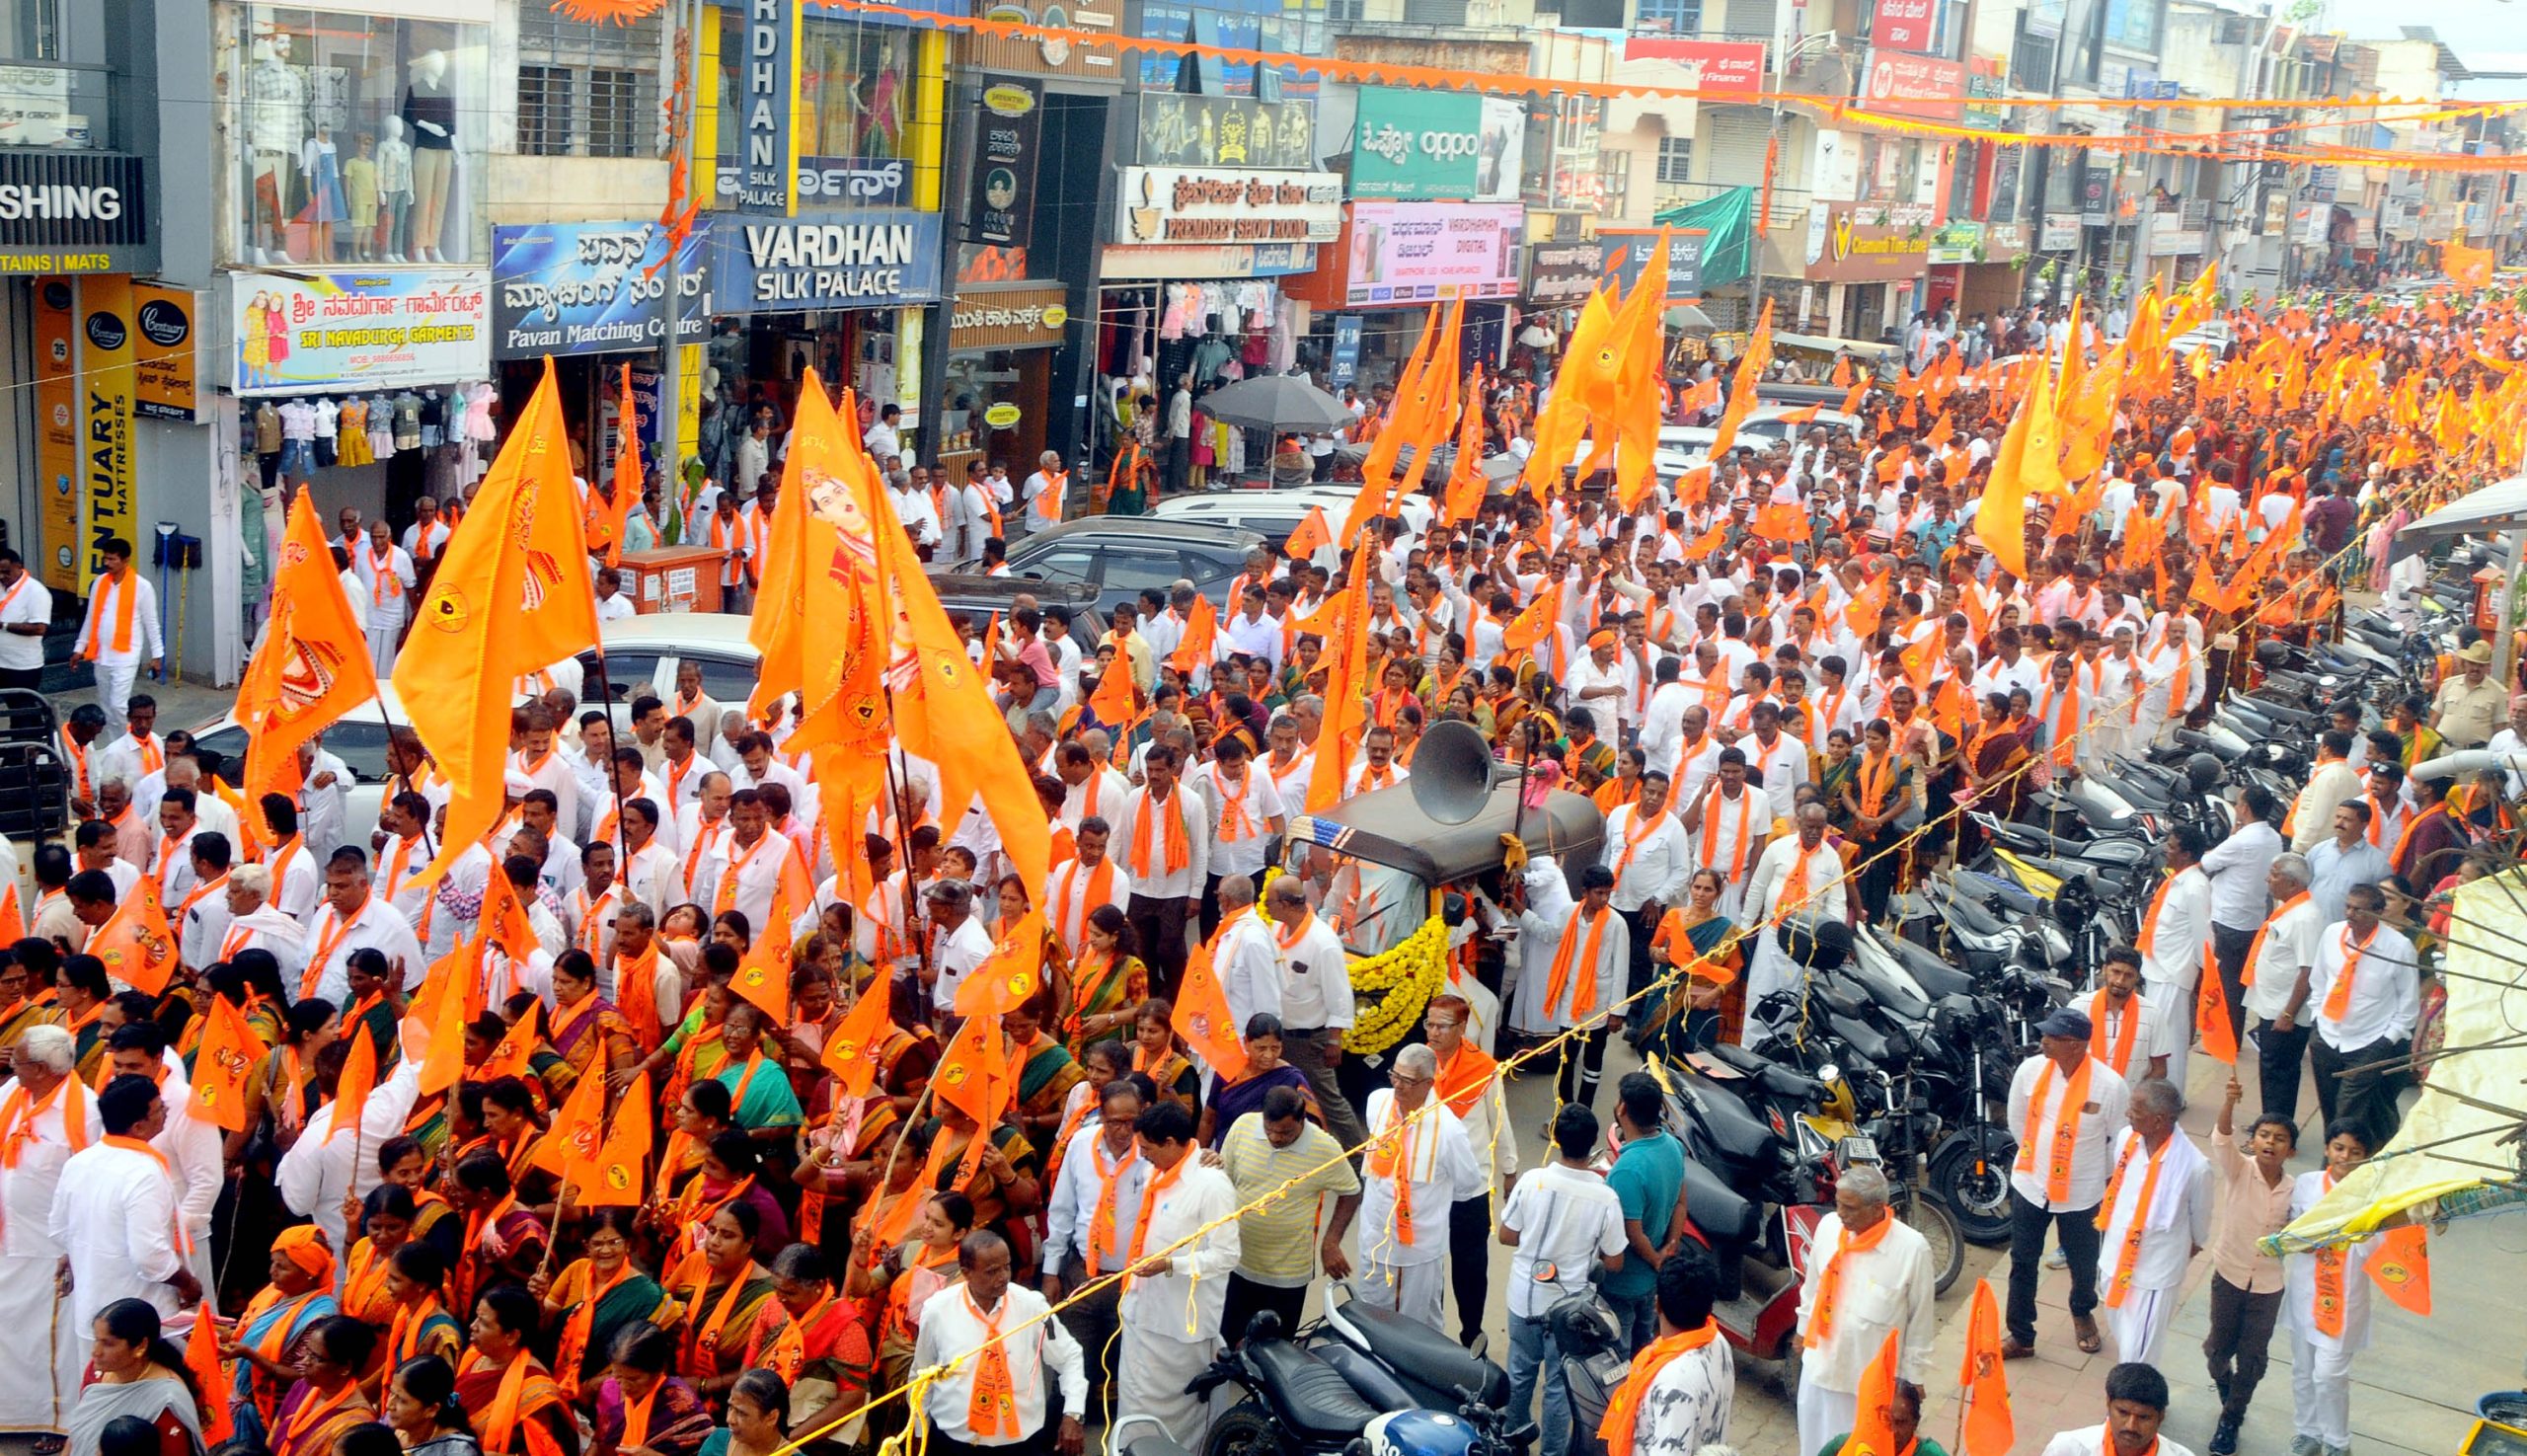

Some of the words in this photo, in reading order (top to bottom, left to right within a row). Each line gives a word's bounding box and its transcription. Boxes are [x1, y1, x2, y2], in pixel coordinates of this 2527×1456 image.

[750, 172, 777, 186] SILK
[0, 185, 120, 220] SHING
[739, 190, 786, 206] PALACE
[2086, 200, 2100, 209] LG
[1166, 218, 1234, 239] PREMDEEP
[1235, 218, 1271, 239] SHOW
[1272, 218, 1308, 238] ROOM
[745, 225, 912, 268] VARDHAN
[0, 255, 51, 271] TAINS
[64, 254, 111, 270] MATS
[756, 272, 810, 300] SILK
[815, 269, 901, 297] PALACE
[292, 293, 315, 323] ಶ್ರೀ
[300, 331, 322, 349] SRI
[327, 328, 406, 348] NAVADURGA
[410, 324, 475, 345] GARMENTS
[507, 329, 562, 348] Pavan
[567, 323, 644, 343] Matching
[649, 317, 703, 337] Cetre
[115, 394, 127, 514] MATTRESSES
